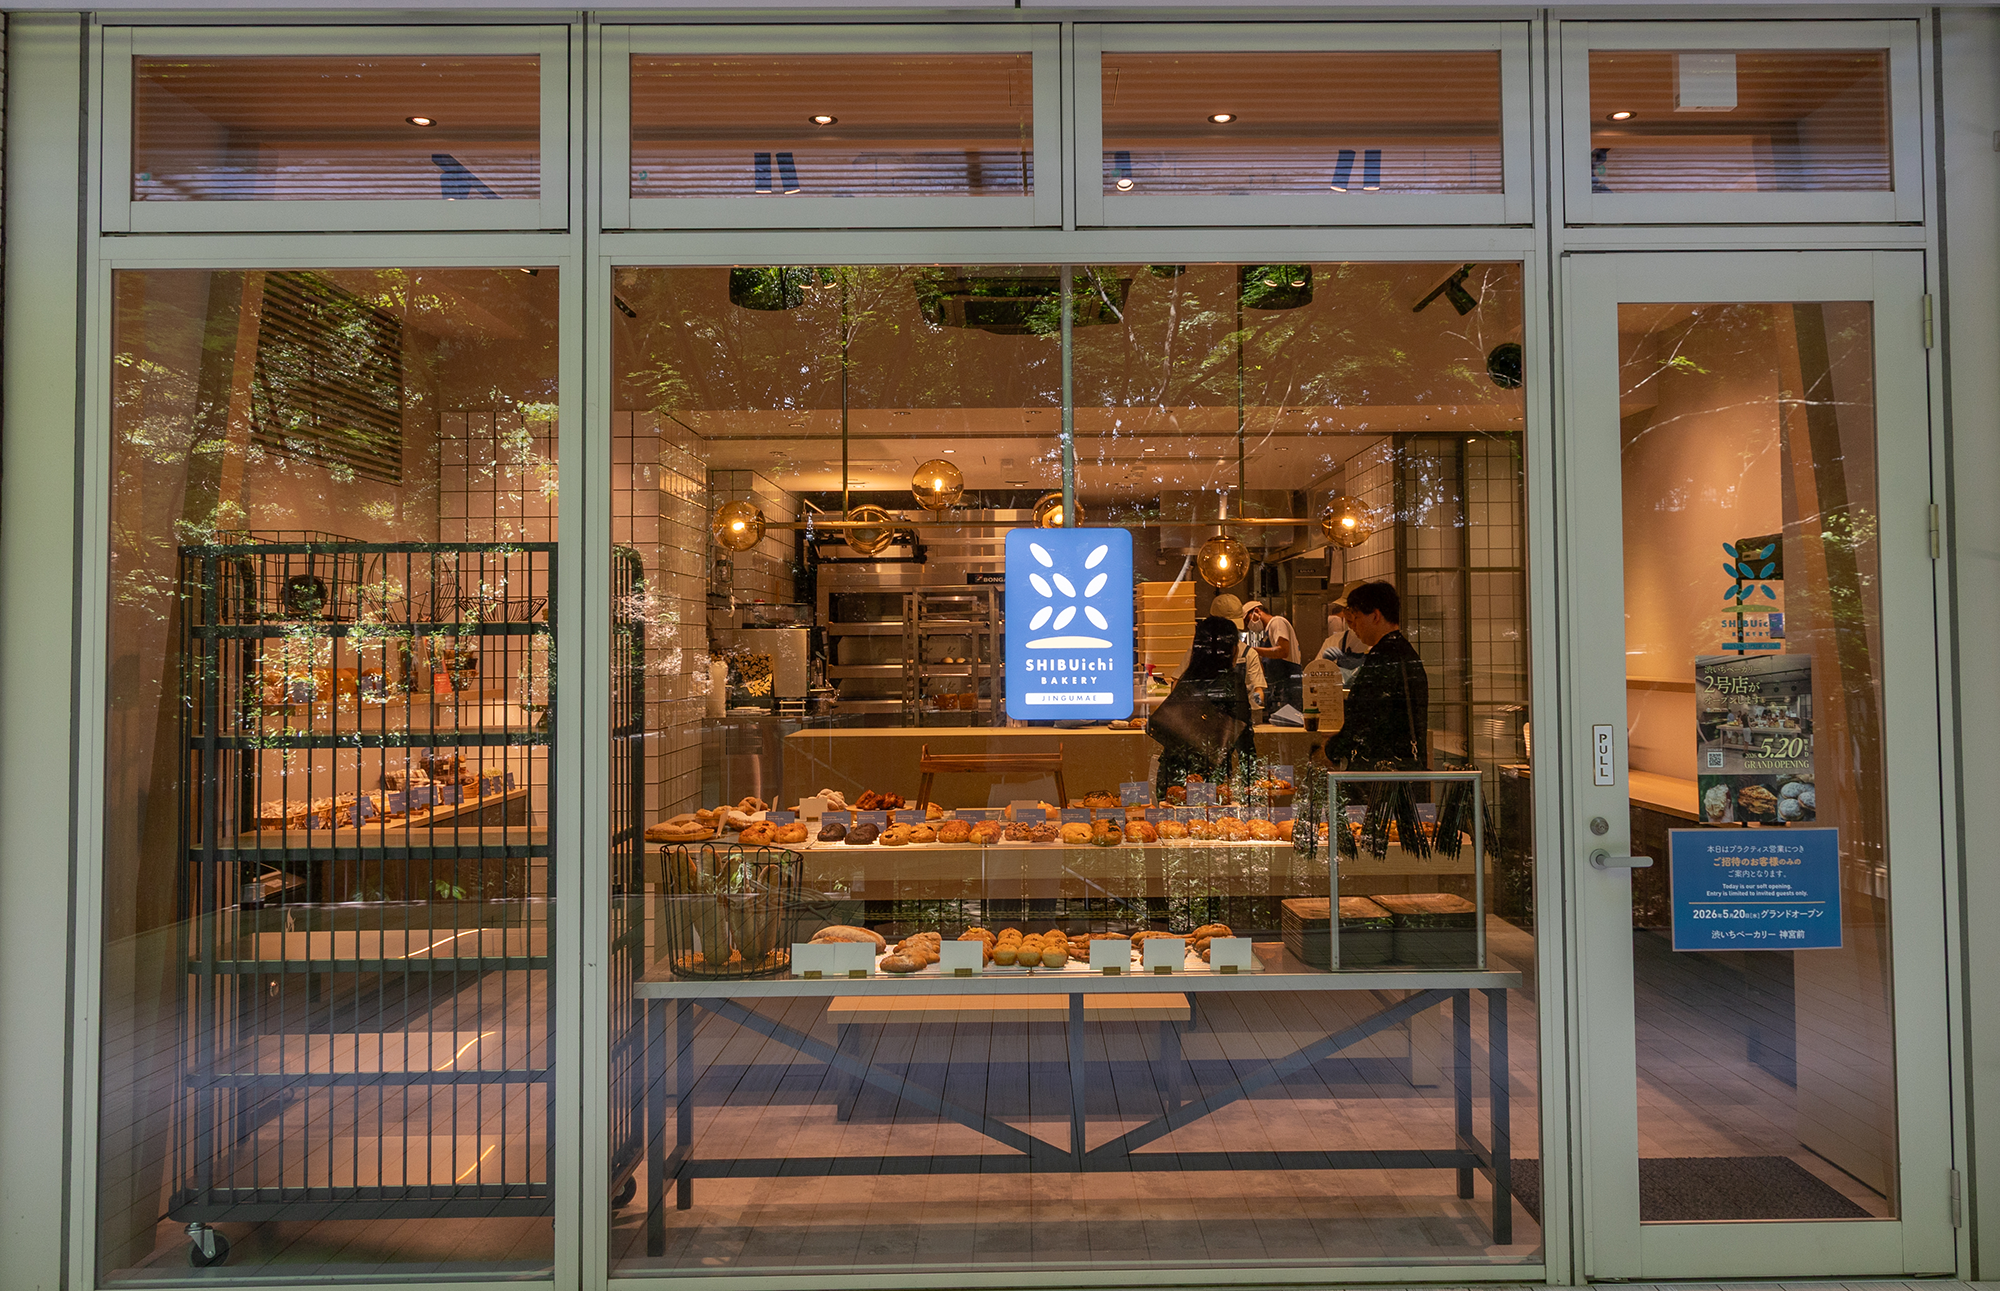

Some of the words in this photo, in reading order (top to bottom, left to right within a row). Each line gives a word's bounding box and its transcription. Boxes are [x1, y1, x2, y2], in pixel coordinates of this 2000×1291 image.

[1025, 658, 1113, 671] SHIBUichi
[1041, 676, 1098, 685] BAKERY
[1704, 675, 1760, 694] 2号店が
[1758, 737, 1804, 759] 5.20
[1599, 733, 1609, 777] PULL
[1744, 760, 1773, 769] GRAND
[1774, 760, 1810, 769] OPENING
[1707, 845, 1804, 854] 本日はプラクティス営業につき
[1713, 856, 1802, 867] ご招待のお客様のみの
[1728, 869, 1787, 878] ご案内となります。
[1711, 930, 1776, 939] 渋いちベーカリー
[1779, 930, 1806, 939] 神宮前
